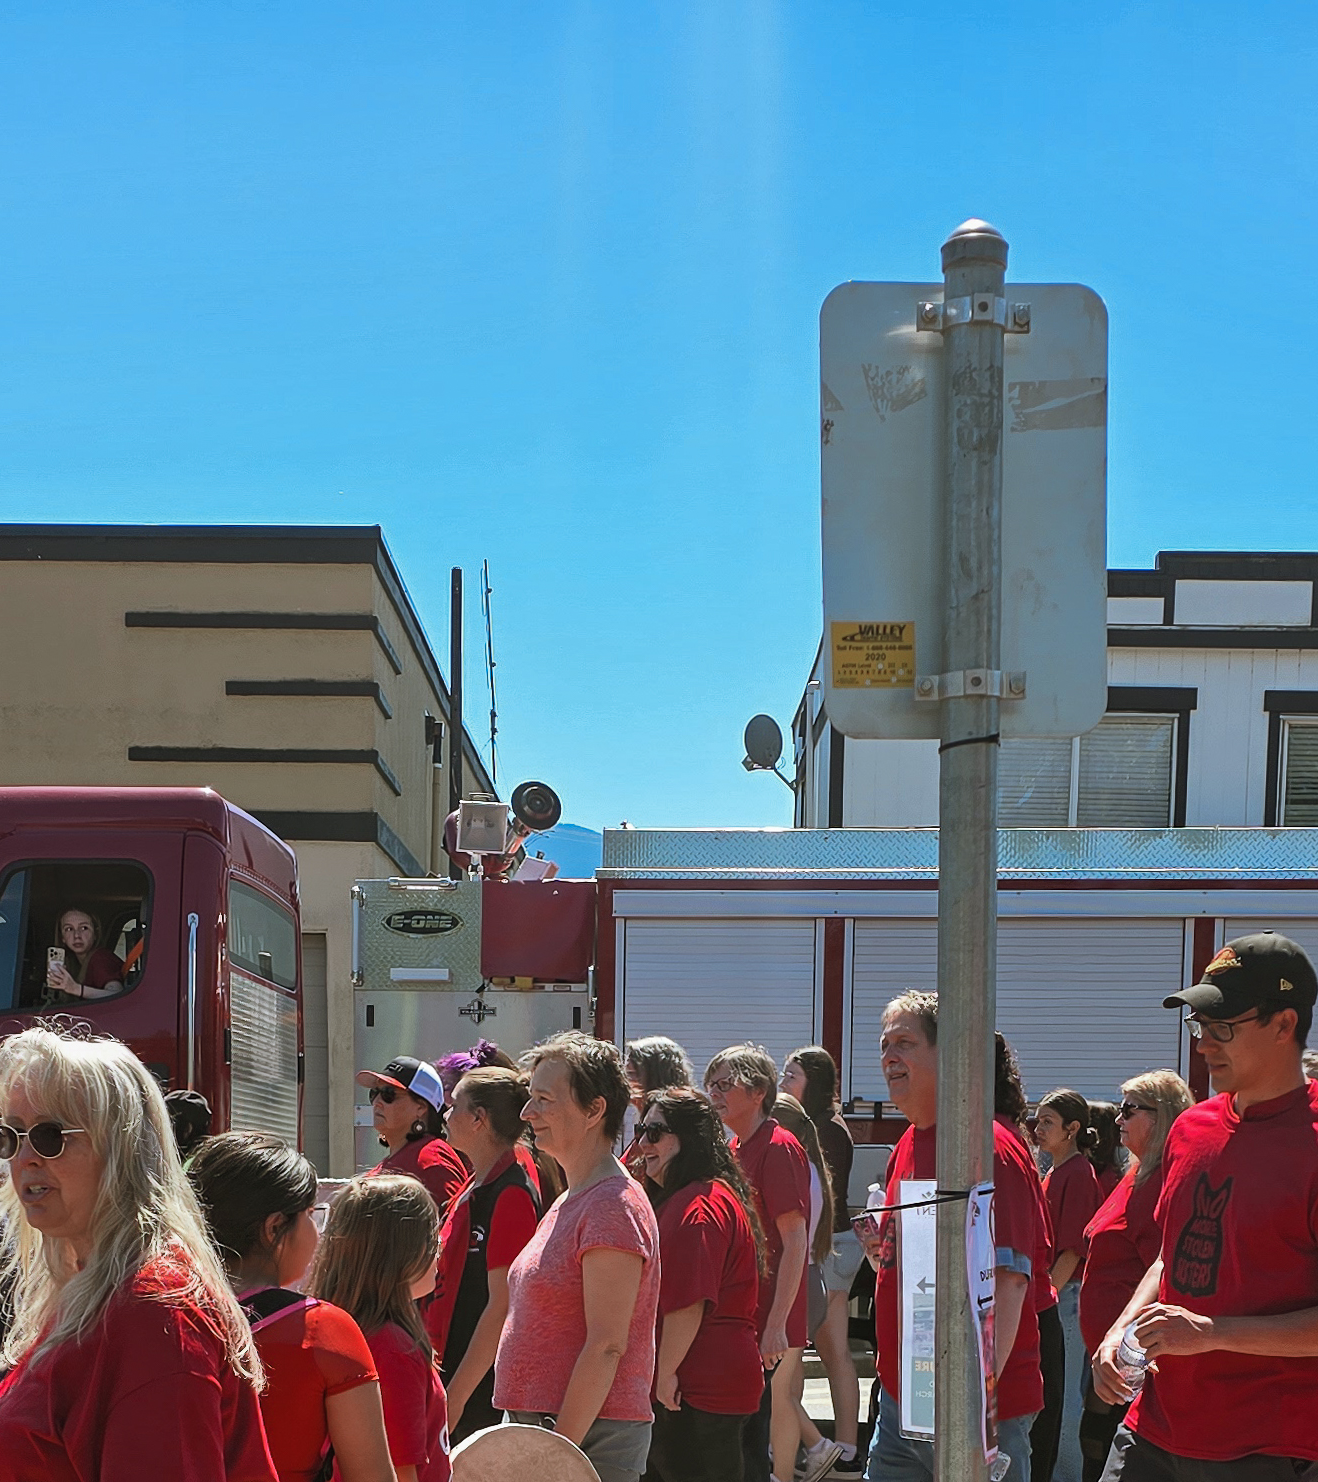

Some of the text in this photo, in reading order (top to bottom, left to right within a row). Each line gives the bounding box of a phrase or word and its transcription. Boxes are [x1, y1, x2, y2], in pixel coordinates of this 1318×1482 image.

[858, 624, 907, 636] VALLEY
[865, 653, 886, 661] 2020
[390, 915, 453, 928] E-ONE
[1196, 1182, 1228, 1219] NO
